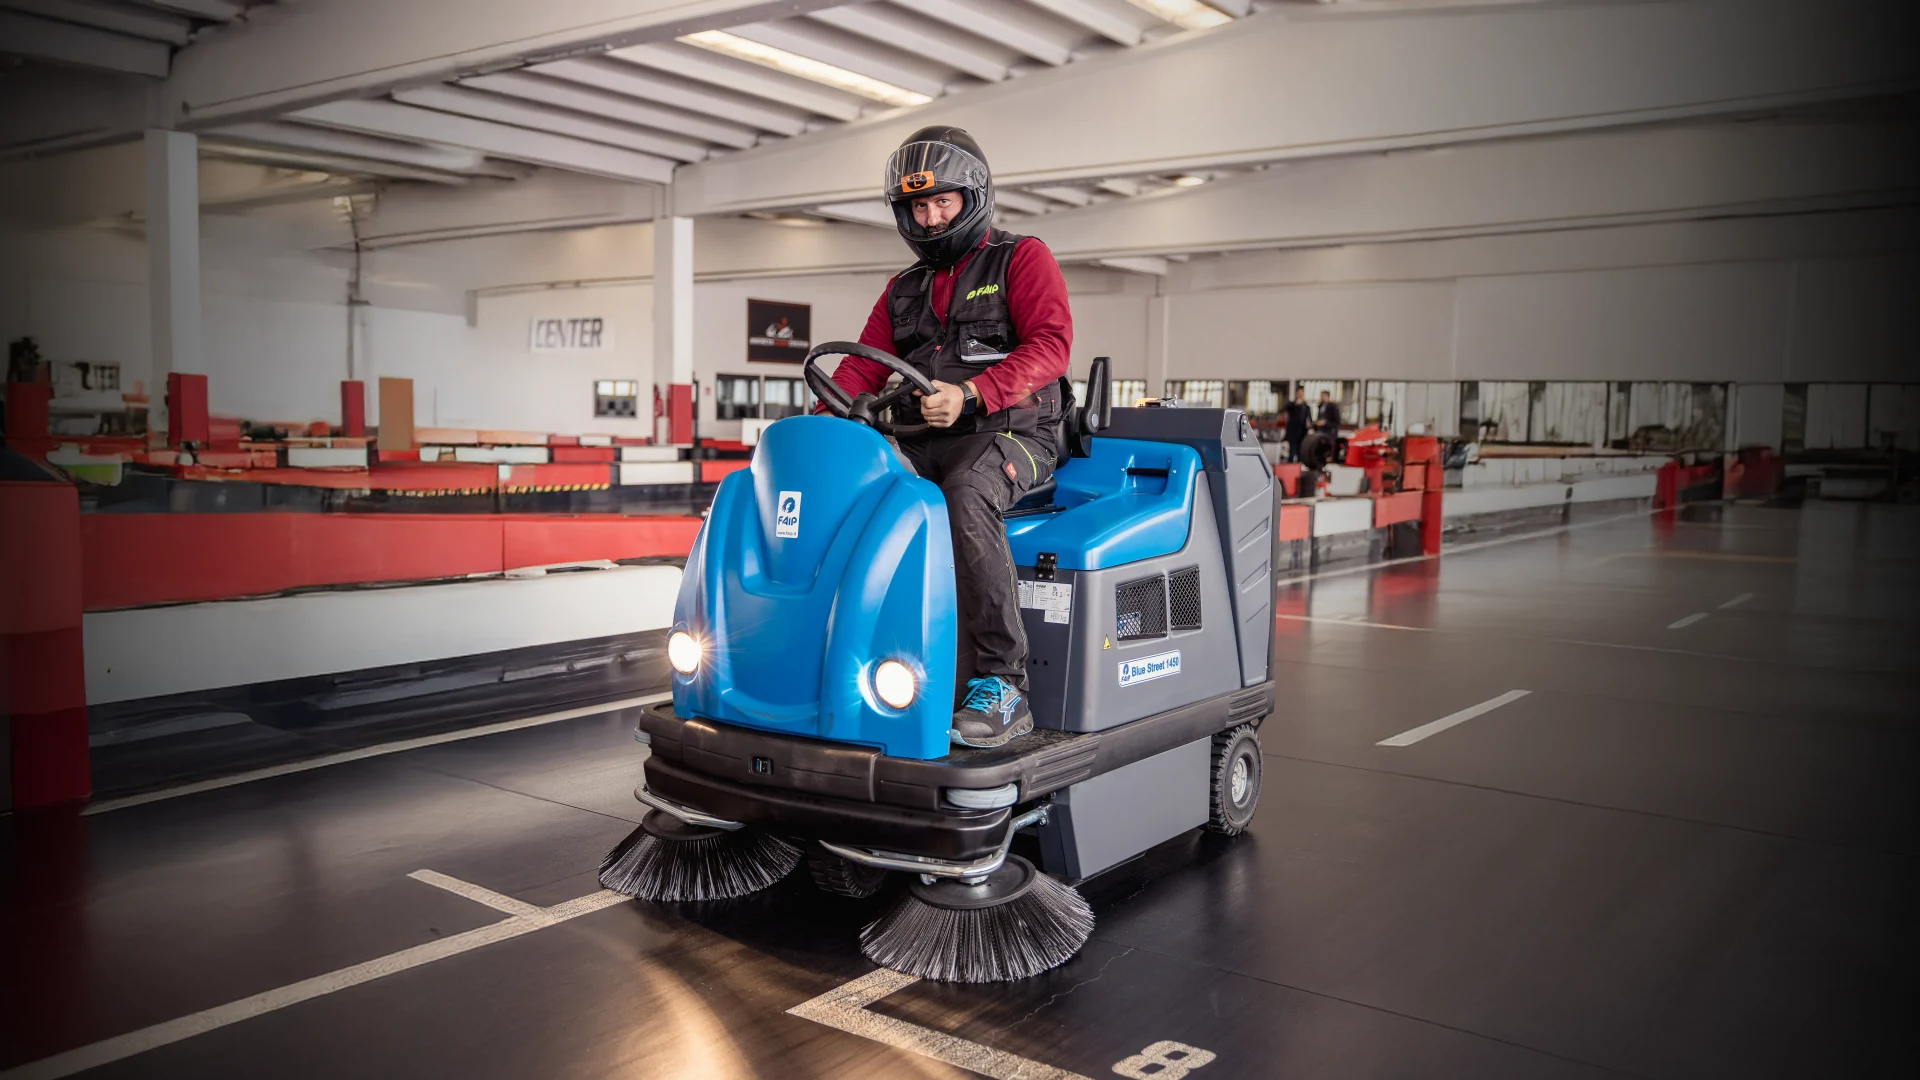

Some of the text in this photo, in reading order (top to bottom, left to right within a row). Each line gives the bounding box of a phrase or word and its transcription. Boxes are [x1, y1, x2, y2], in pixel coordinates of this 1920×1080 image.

[976, 284, 999, 296] FAIP
[536, 318, 603, 348] CENTER
[778, 516, 798, 526] FAIP
[1131, 656, 1179, 678] Blue Street 1450
[1112, 1040, 1216, 1080] 8
